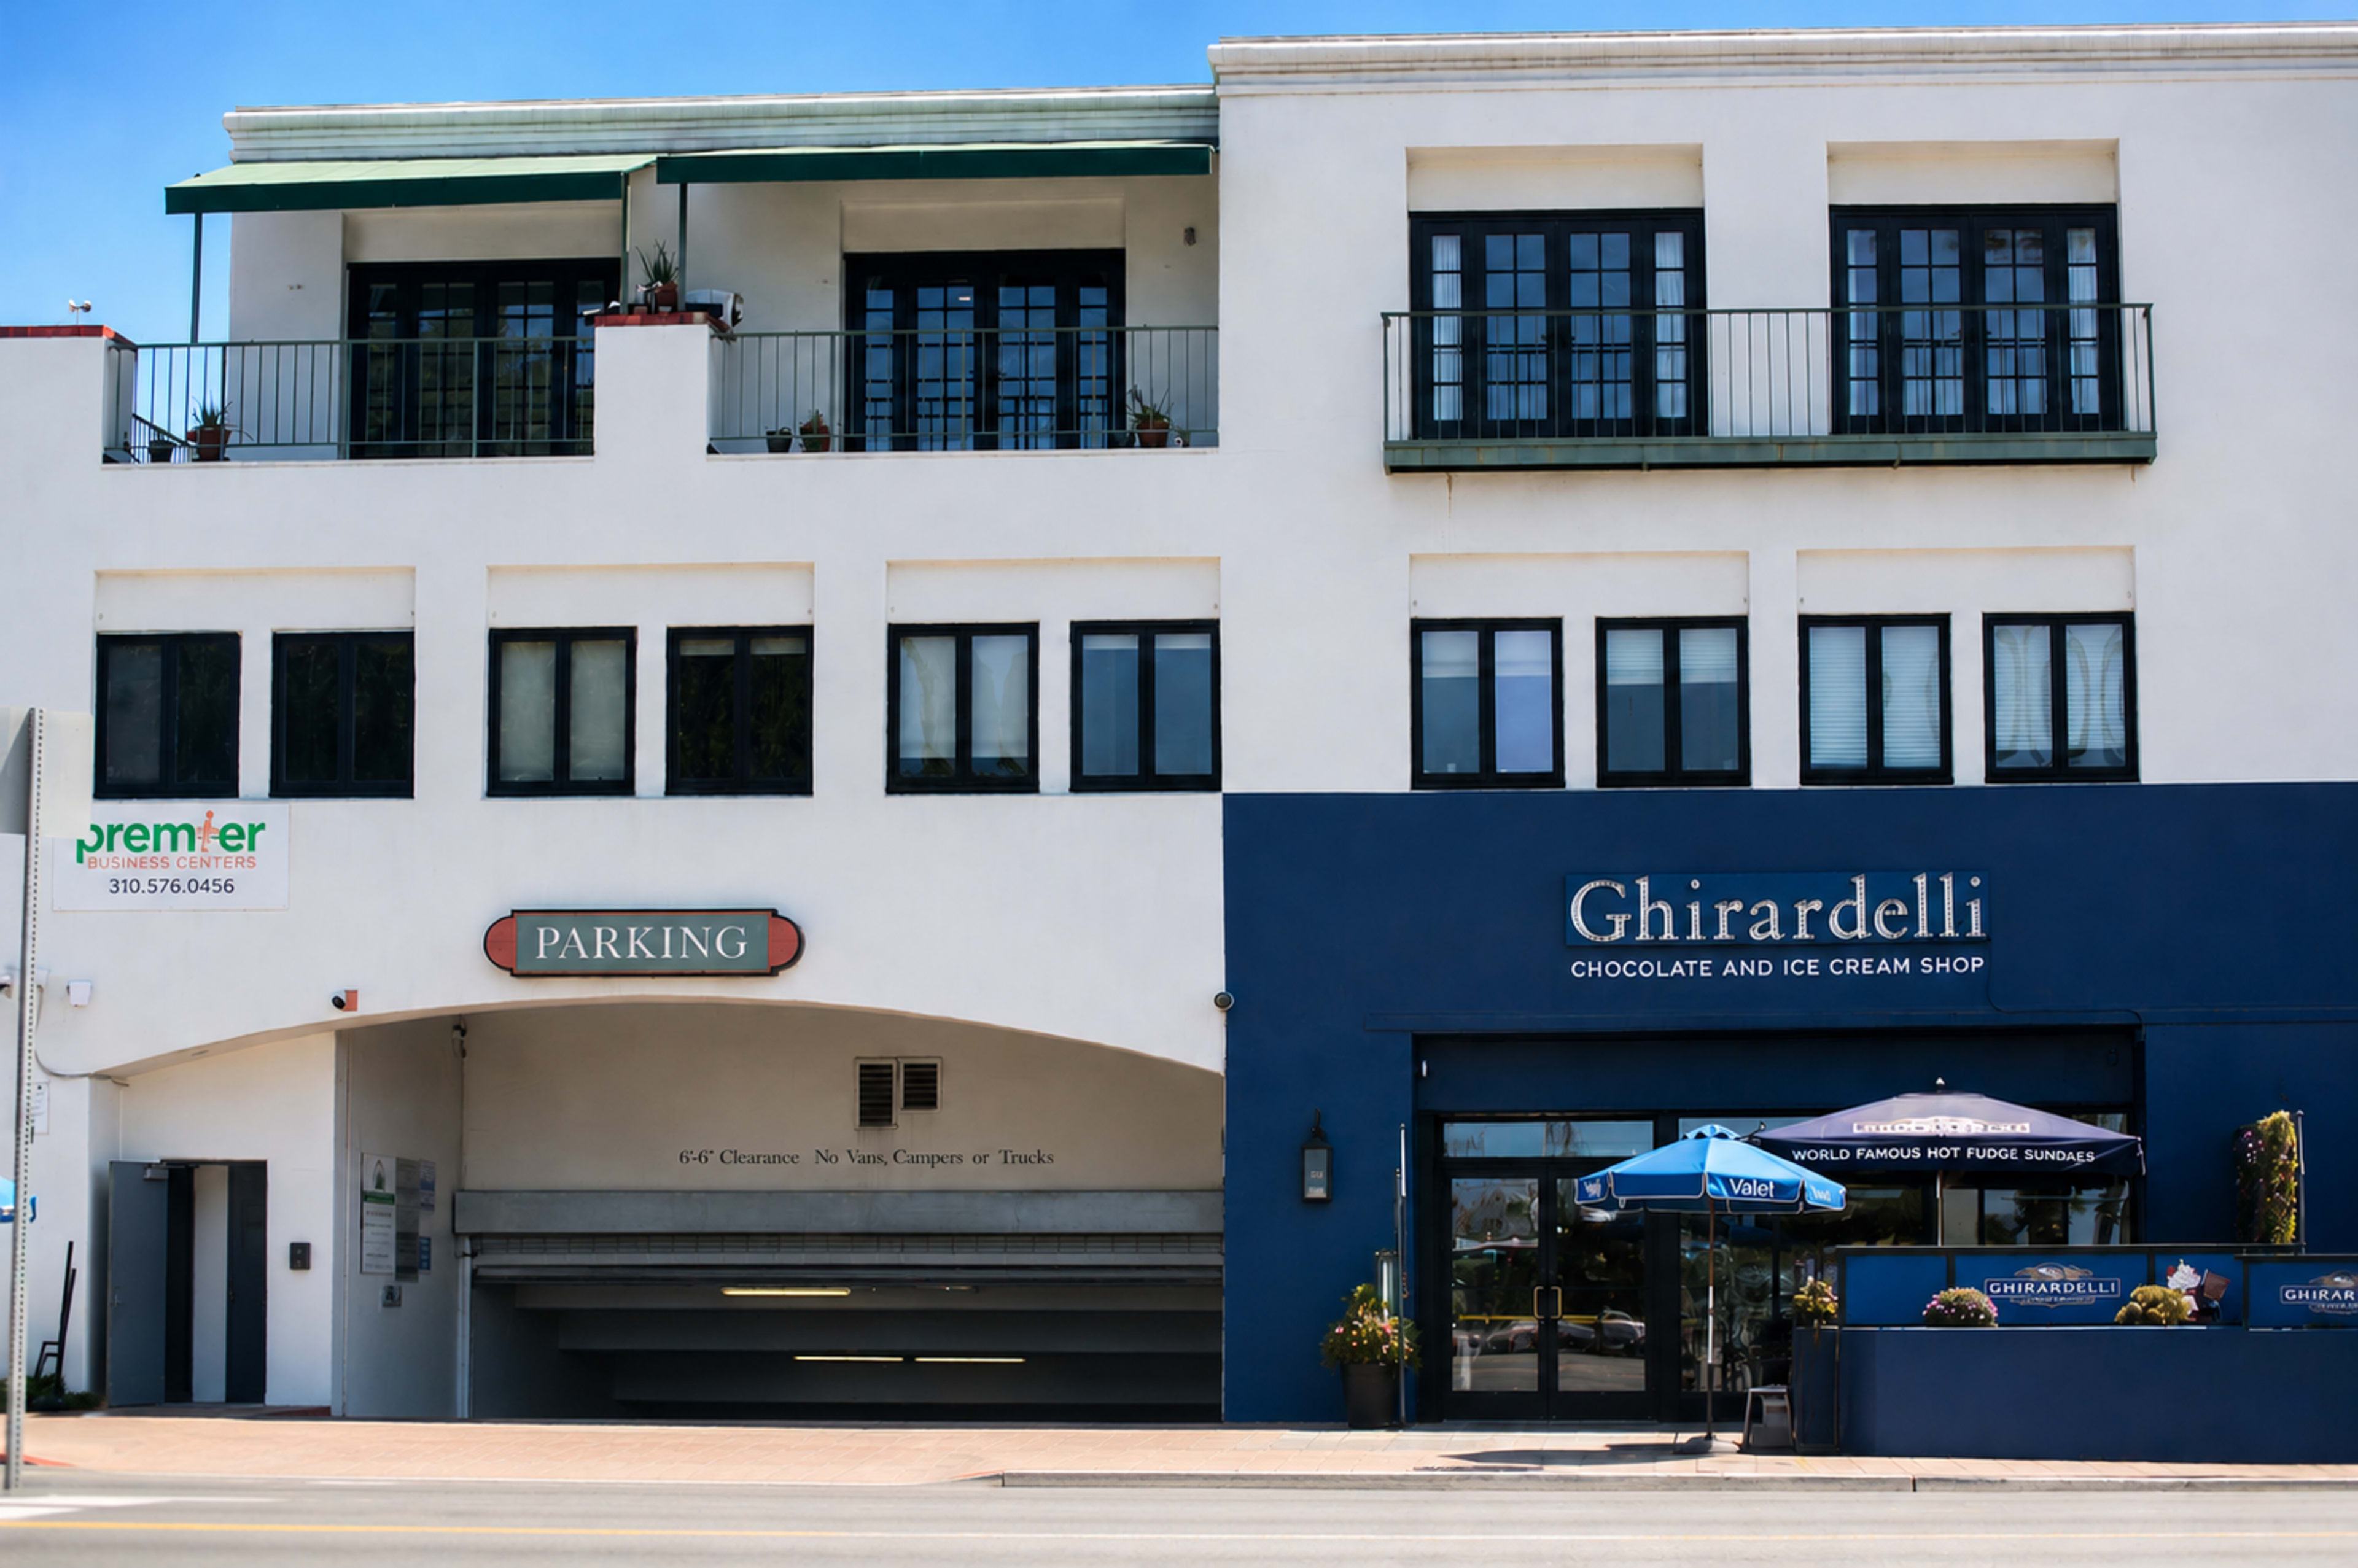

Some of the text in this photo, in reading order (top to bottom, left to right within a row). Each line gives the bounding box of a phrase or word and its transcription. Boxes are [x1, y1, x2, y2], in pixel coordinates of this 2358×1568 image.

[88, 856, 257, 869] BUSINESS CENTERS
[109, 878, 235, 894] 310.576.0456
[1570, 872, 1987, 942] Ghirardelli
[535, 926, 747, 959] PARKING
[1571, 957, 1984, 977] CHOCOLATE AND ICE CREAM SHOP
[719, 1149, 800, 1164] Clearance
[815, 1149, 839, 1164] No
[846, 1149, 888, 1166] Vans,
[893, 1149, 963, 1168] Campers
[972, 1153, 989, 1164] or
[998, 1149, 1054, 1164] Trucks
[1792, 1147, 2095, 1163] WORLD FAMOUS HOT FUDGE SUNDAES
[1729, 1178, 1775, 1198] Valet
[1990, 1282, 2115, 1294] GHIRARDELLI
